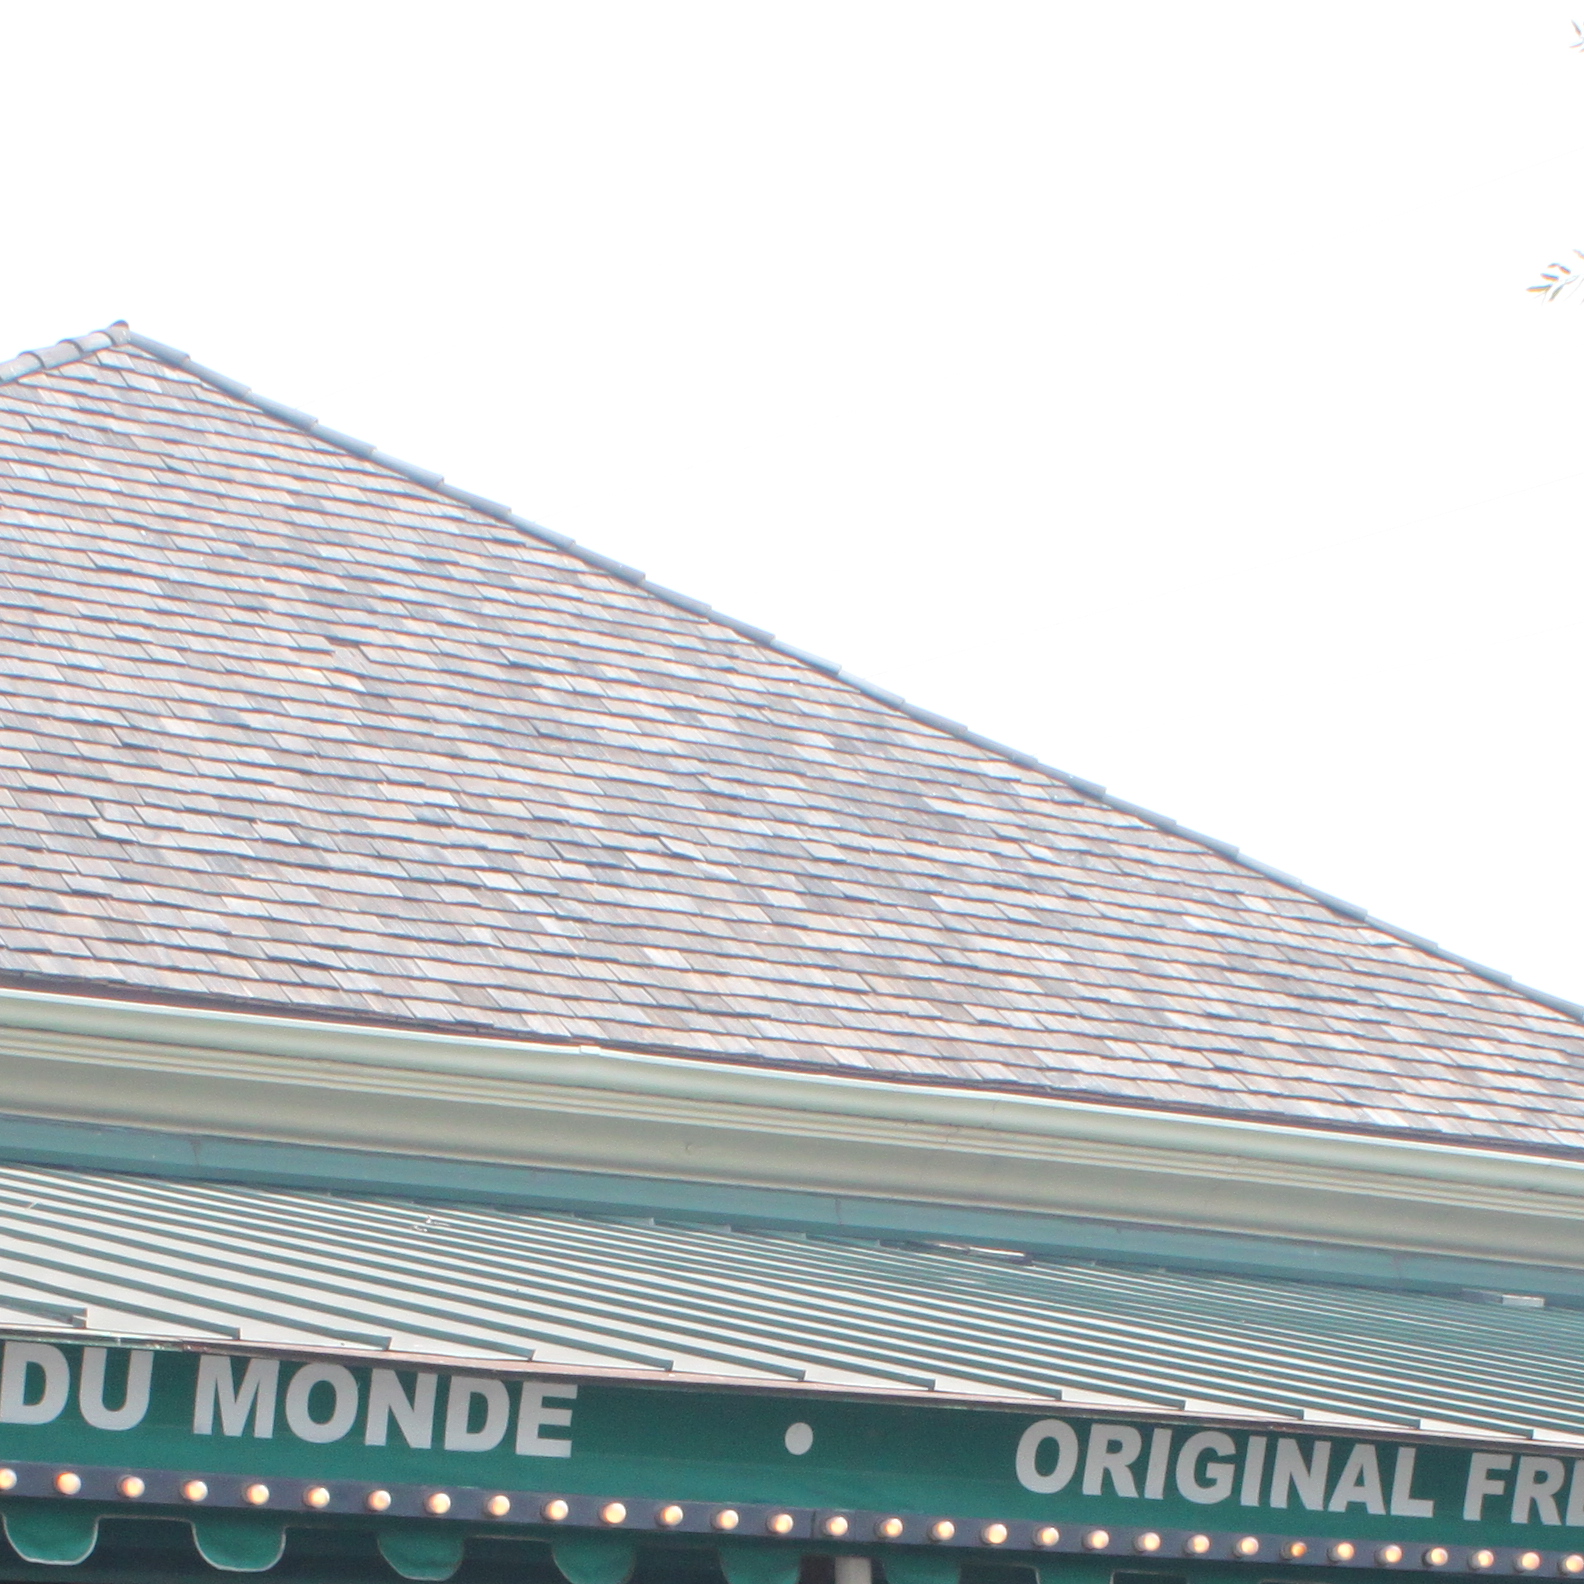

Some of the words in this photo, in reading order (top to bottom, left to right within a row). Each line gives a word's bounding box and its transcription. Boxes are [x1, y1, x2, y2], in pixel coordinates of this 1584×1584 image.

[0, 1342, 152, 1430] DU
[192, 1357, 578, 1458] MONDE
[1015, 1417, 1436, 1518] ORIGINAL
